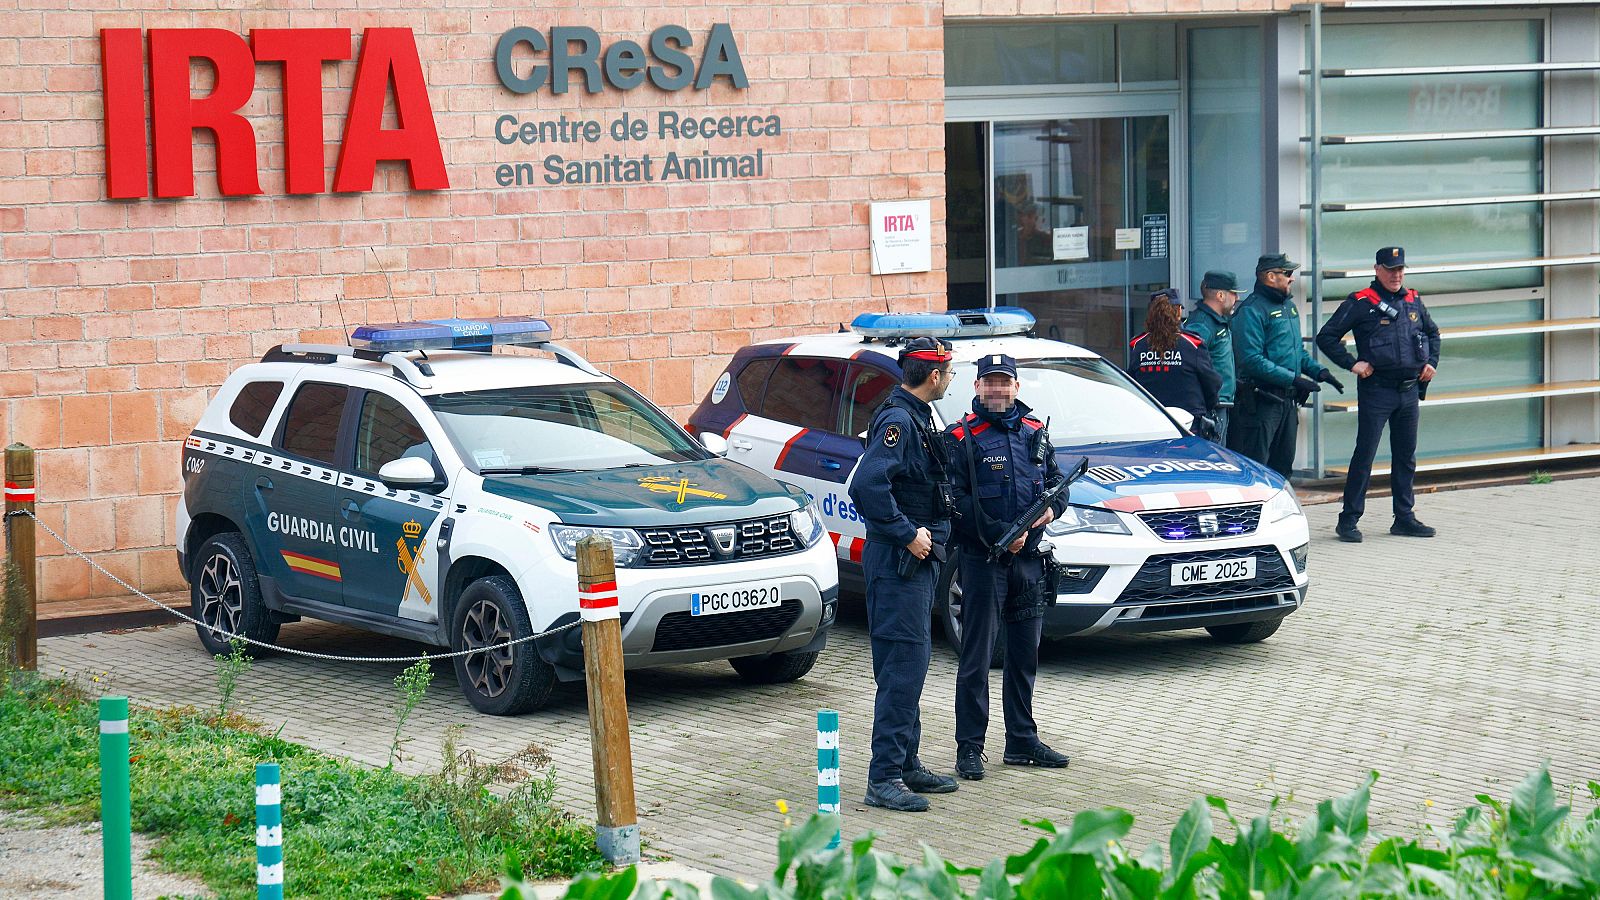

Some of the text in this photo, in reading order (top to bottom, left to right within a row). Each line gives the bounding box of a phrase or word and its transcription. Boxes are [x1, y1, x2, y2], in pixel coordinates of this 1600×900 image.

[495, 23, 750, 94] CReSA
[100, 28, 450, 198] IRTA
[494, 111, 782, 145] Centre de Recerca
[495, 149, 763, 187] en Sanitat Animal
[884, 214, 915, 233] IRTA
[1140, 350, 1182, 361] POLCIA
[716, 380, 728, 391] 112
[1123, 459, 1243, 478] policia
[267, 511, 379, 554] GUARDIA CIVIL
[1181, 560, 1248, 582] CME 2025
[701, 592, 729, 612] PGC
